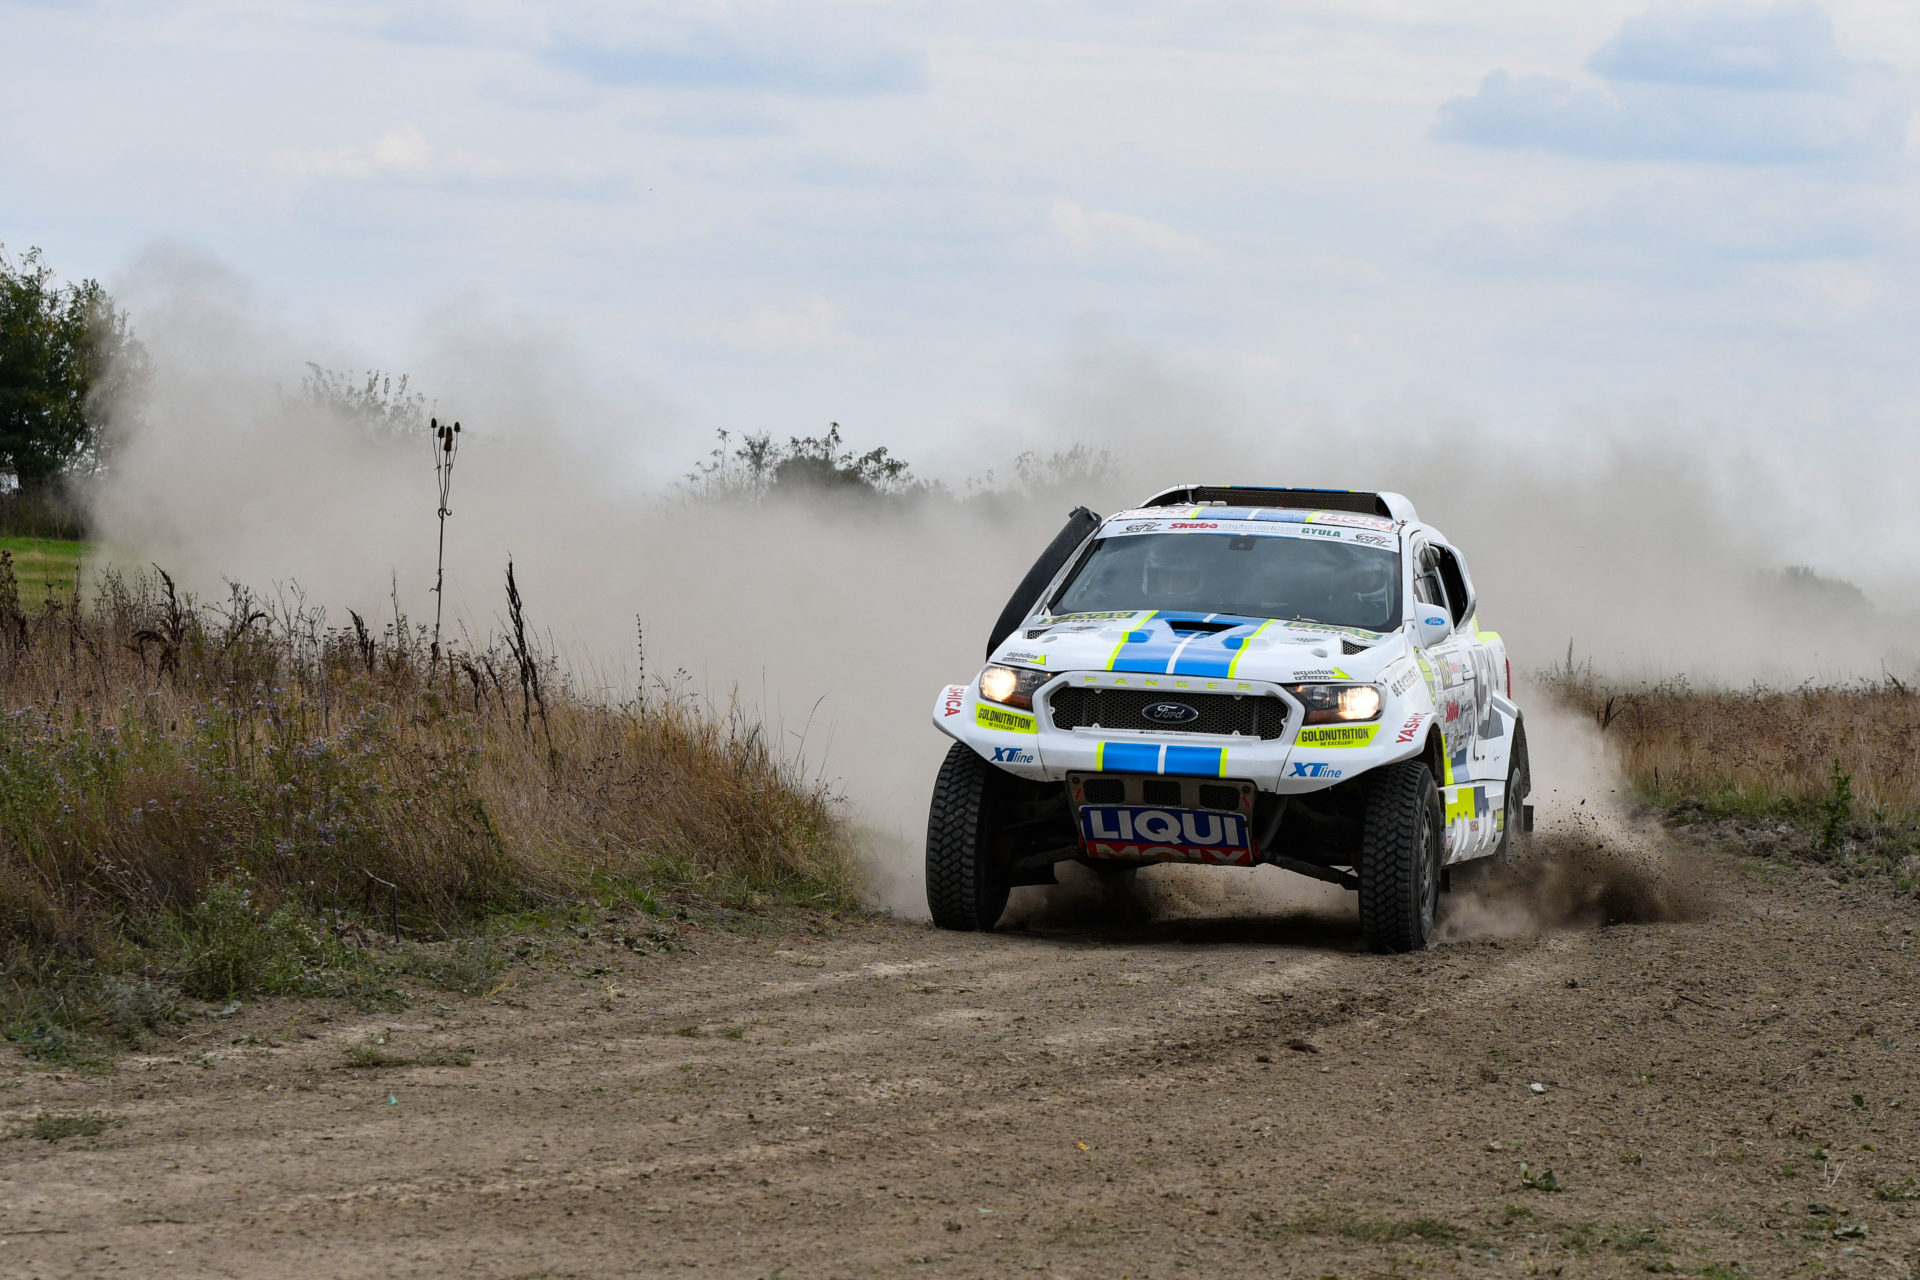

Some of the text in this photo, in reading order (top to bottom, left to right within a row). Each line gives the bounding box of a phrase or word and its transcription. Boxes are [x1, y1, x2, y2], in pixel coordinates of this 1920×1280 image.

[1301, 527, 1341, 538] GYULA
[1084, 676, 1251, 692] RANGER
[978, 707, 1032, 730] GOLDNUTRITION
[1153, 704, 1185, 720] Ford
[1301, 728, 1370, 742] GOLDNUTRITION
[990, 747, 1033, 764] XTline
[1288, 762, 1342, 778] XTline
[1090, 810, 1240, 845] LIQUI
